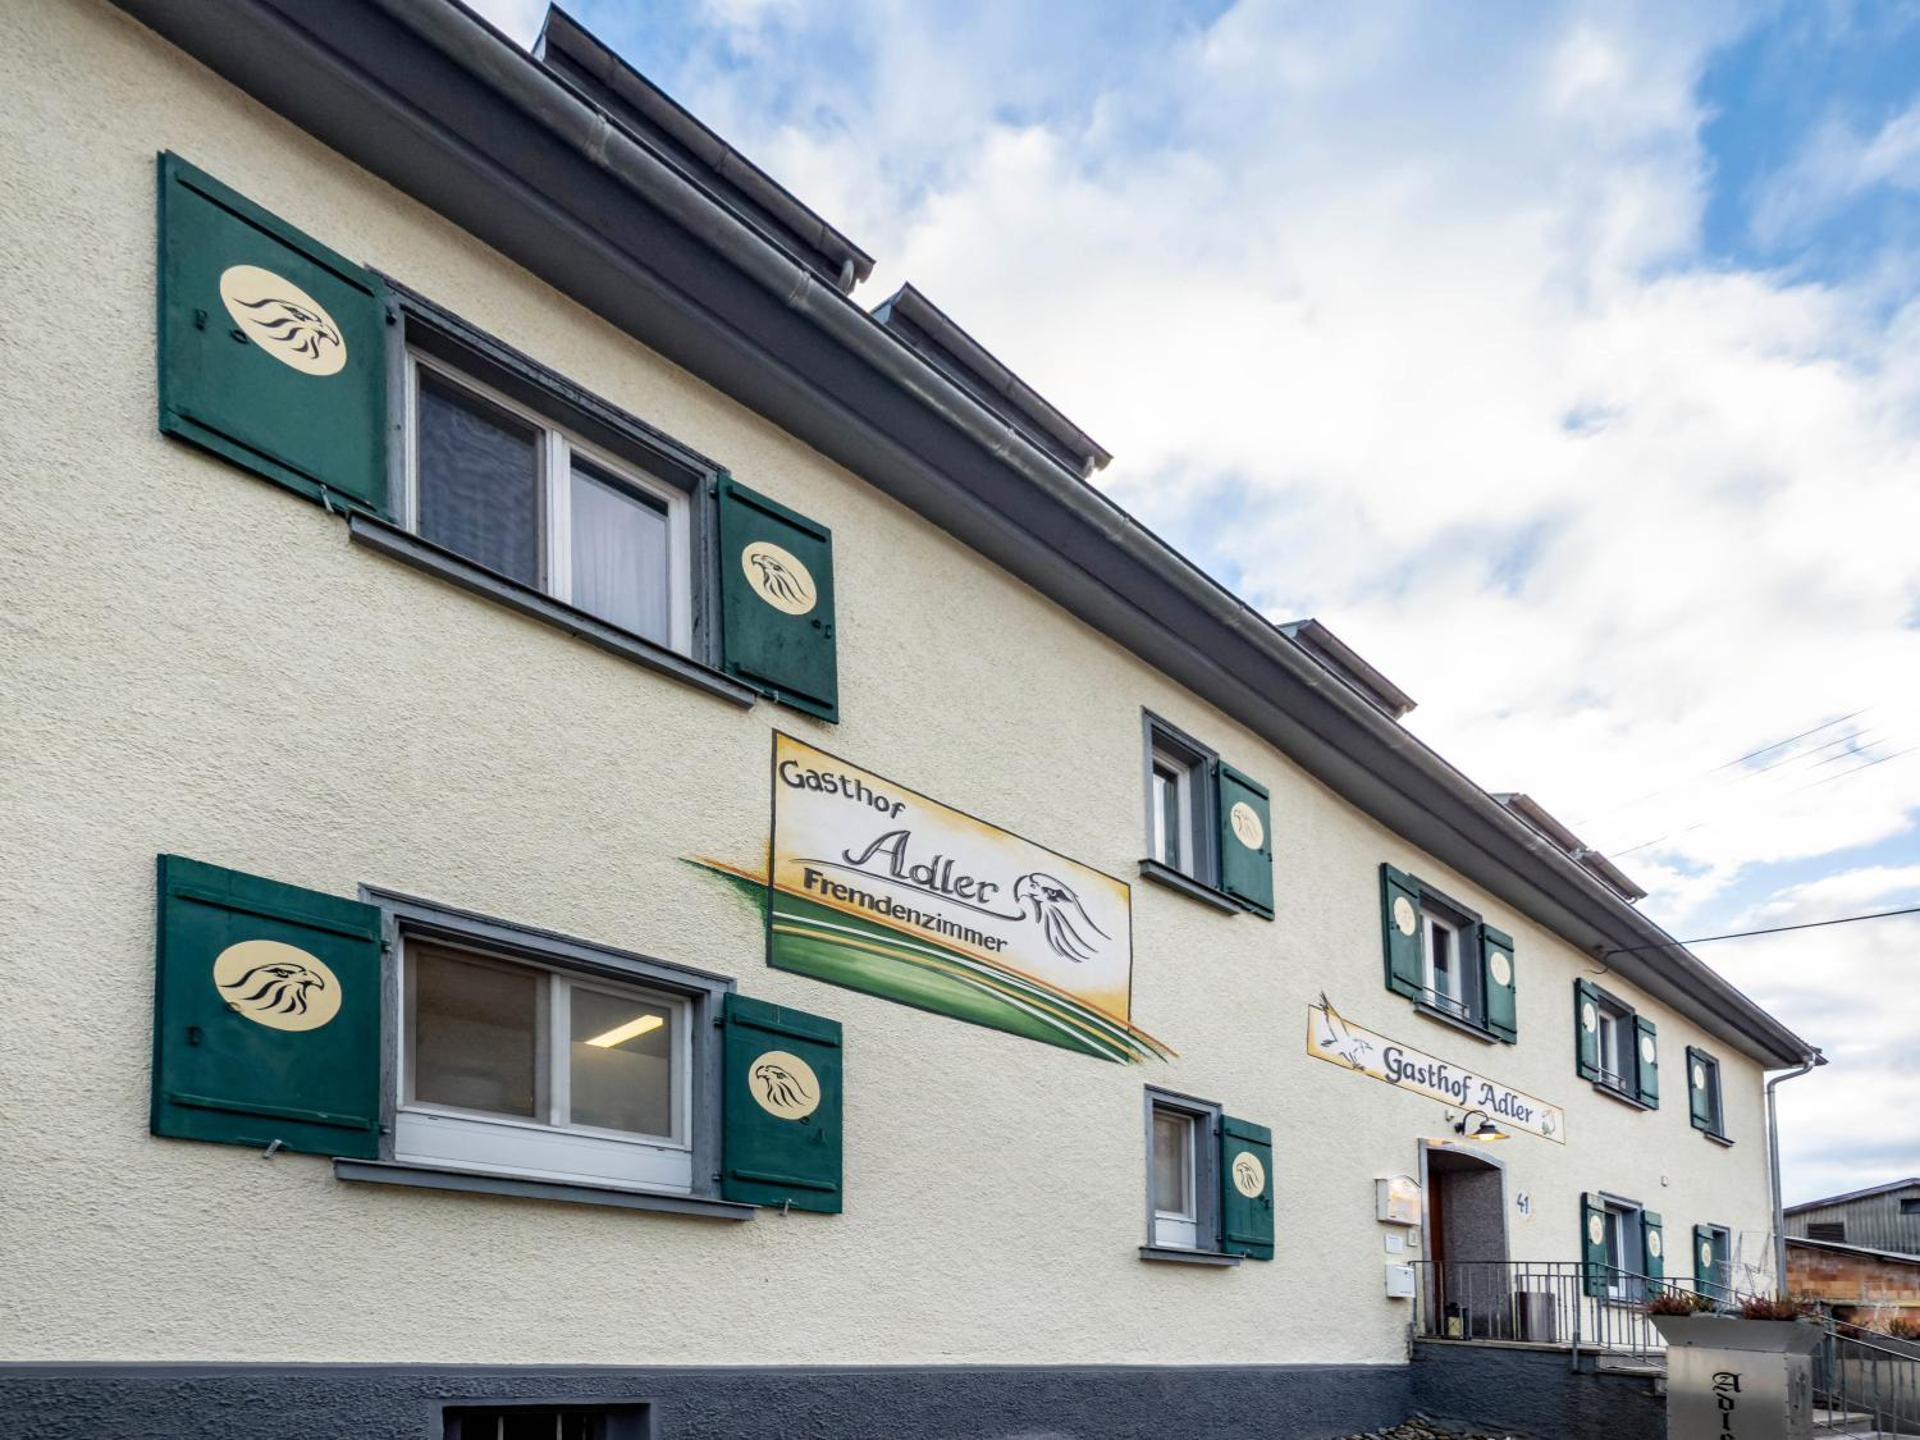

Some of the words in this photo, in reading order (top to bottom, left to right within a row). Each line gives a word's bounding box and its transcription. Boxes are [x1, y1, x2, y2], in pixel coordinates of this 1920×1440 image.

[779, 760, 906, 819] Gasthof
[842, 830, 999, 903] Adler
[803, 868, 1008, 952] Fremdenzimmer
[1383, 1047, 1472, 1106] Gasthof
[1478, 1083, 1533, 1123] Adler
[1516, 1192, 1529, 1214] 41
